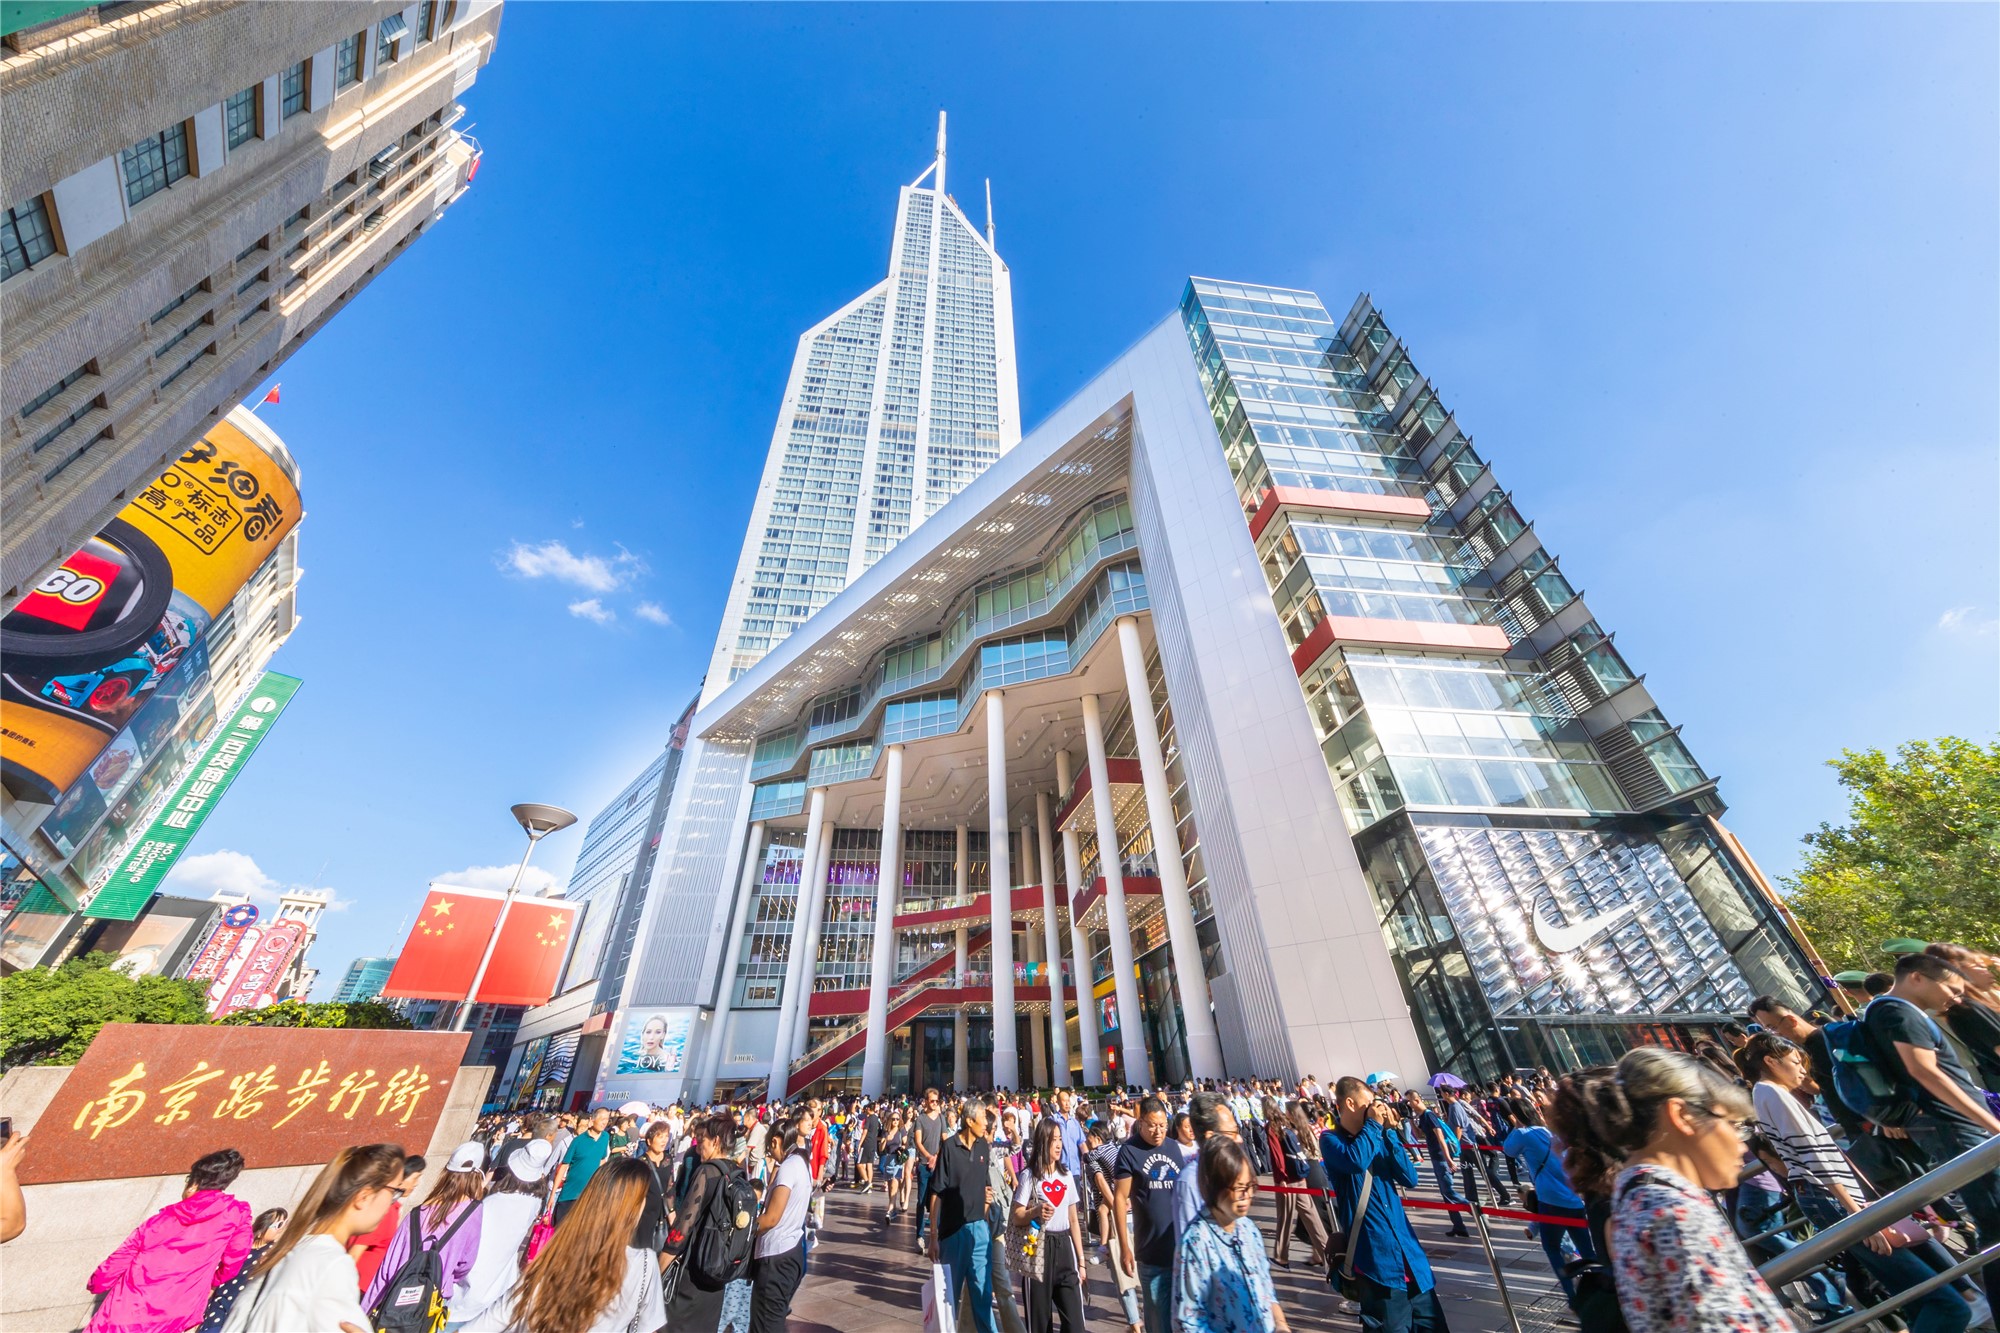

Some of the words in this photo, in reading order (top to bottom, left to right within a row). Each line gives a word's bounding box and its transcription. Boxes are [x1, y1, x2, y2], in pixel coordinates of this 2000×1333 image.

[163, 714, 265, 829] 第一百货商业中心
[124, 840, 155, 872] CENTER
[129, 842, 166, 883] SHOPPING
[227, 955, 275, 1014] 茂昌眼
[633, 1055, 660, 1069] JOY
[73, 1060, 431, 1140] 南京路步行街
[607, 1090, 631, 1101] DIOR
[1149, 1180, 1163, 1189] AND
